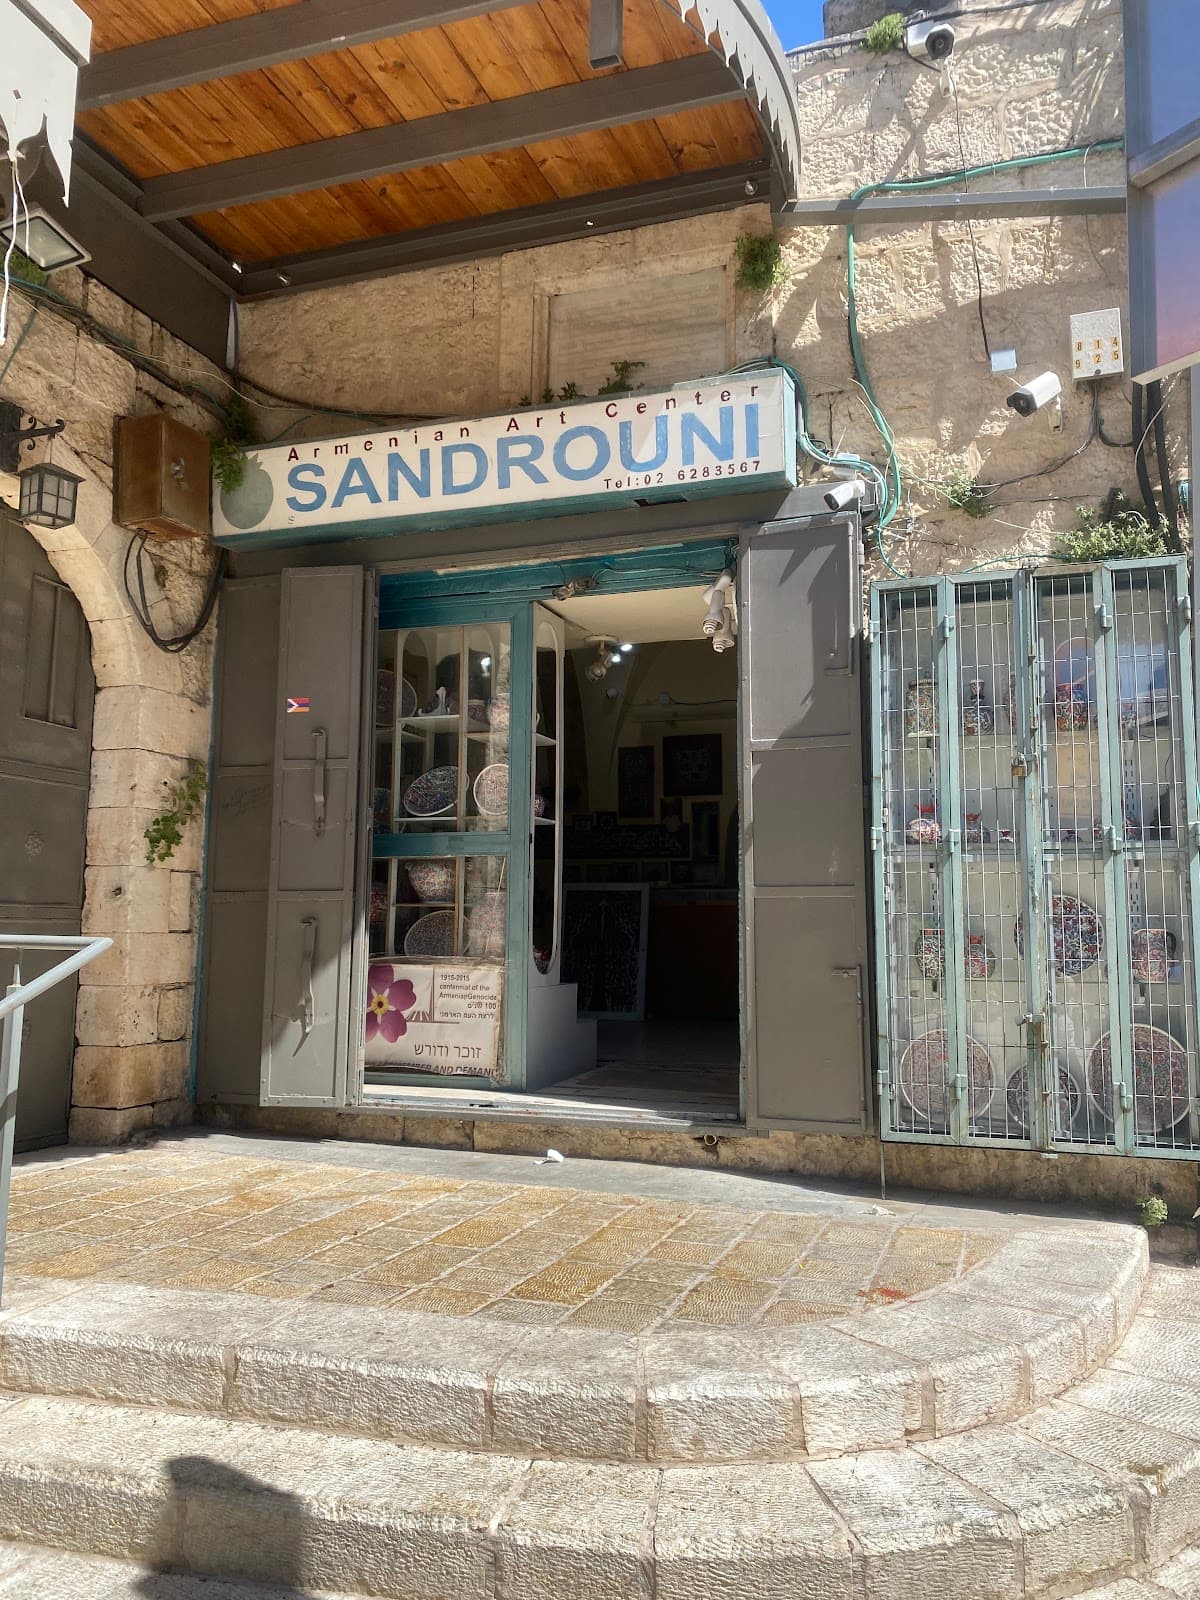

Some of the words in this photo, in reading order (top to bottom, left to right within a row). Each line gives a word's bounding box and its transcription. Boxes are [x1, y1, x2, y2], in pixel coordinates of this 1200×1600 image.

[287, 426, 470, 462] Armenian
[506, 410, 567, 432] Art
[605, 385, 759, 418] Center
[286, 403, 760, 512] SANDROUNI
[677, 460, 760, 481] 6283567
[440, 974, 470, 982] 1915-2015
[485, 1002, 497, 1010] 100
[414, 1043, 449, 1056] ודורש
[454, 1045, 482, 1059] זוכר
